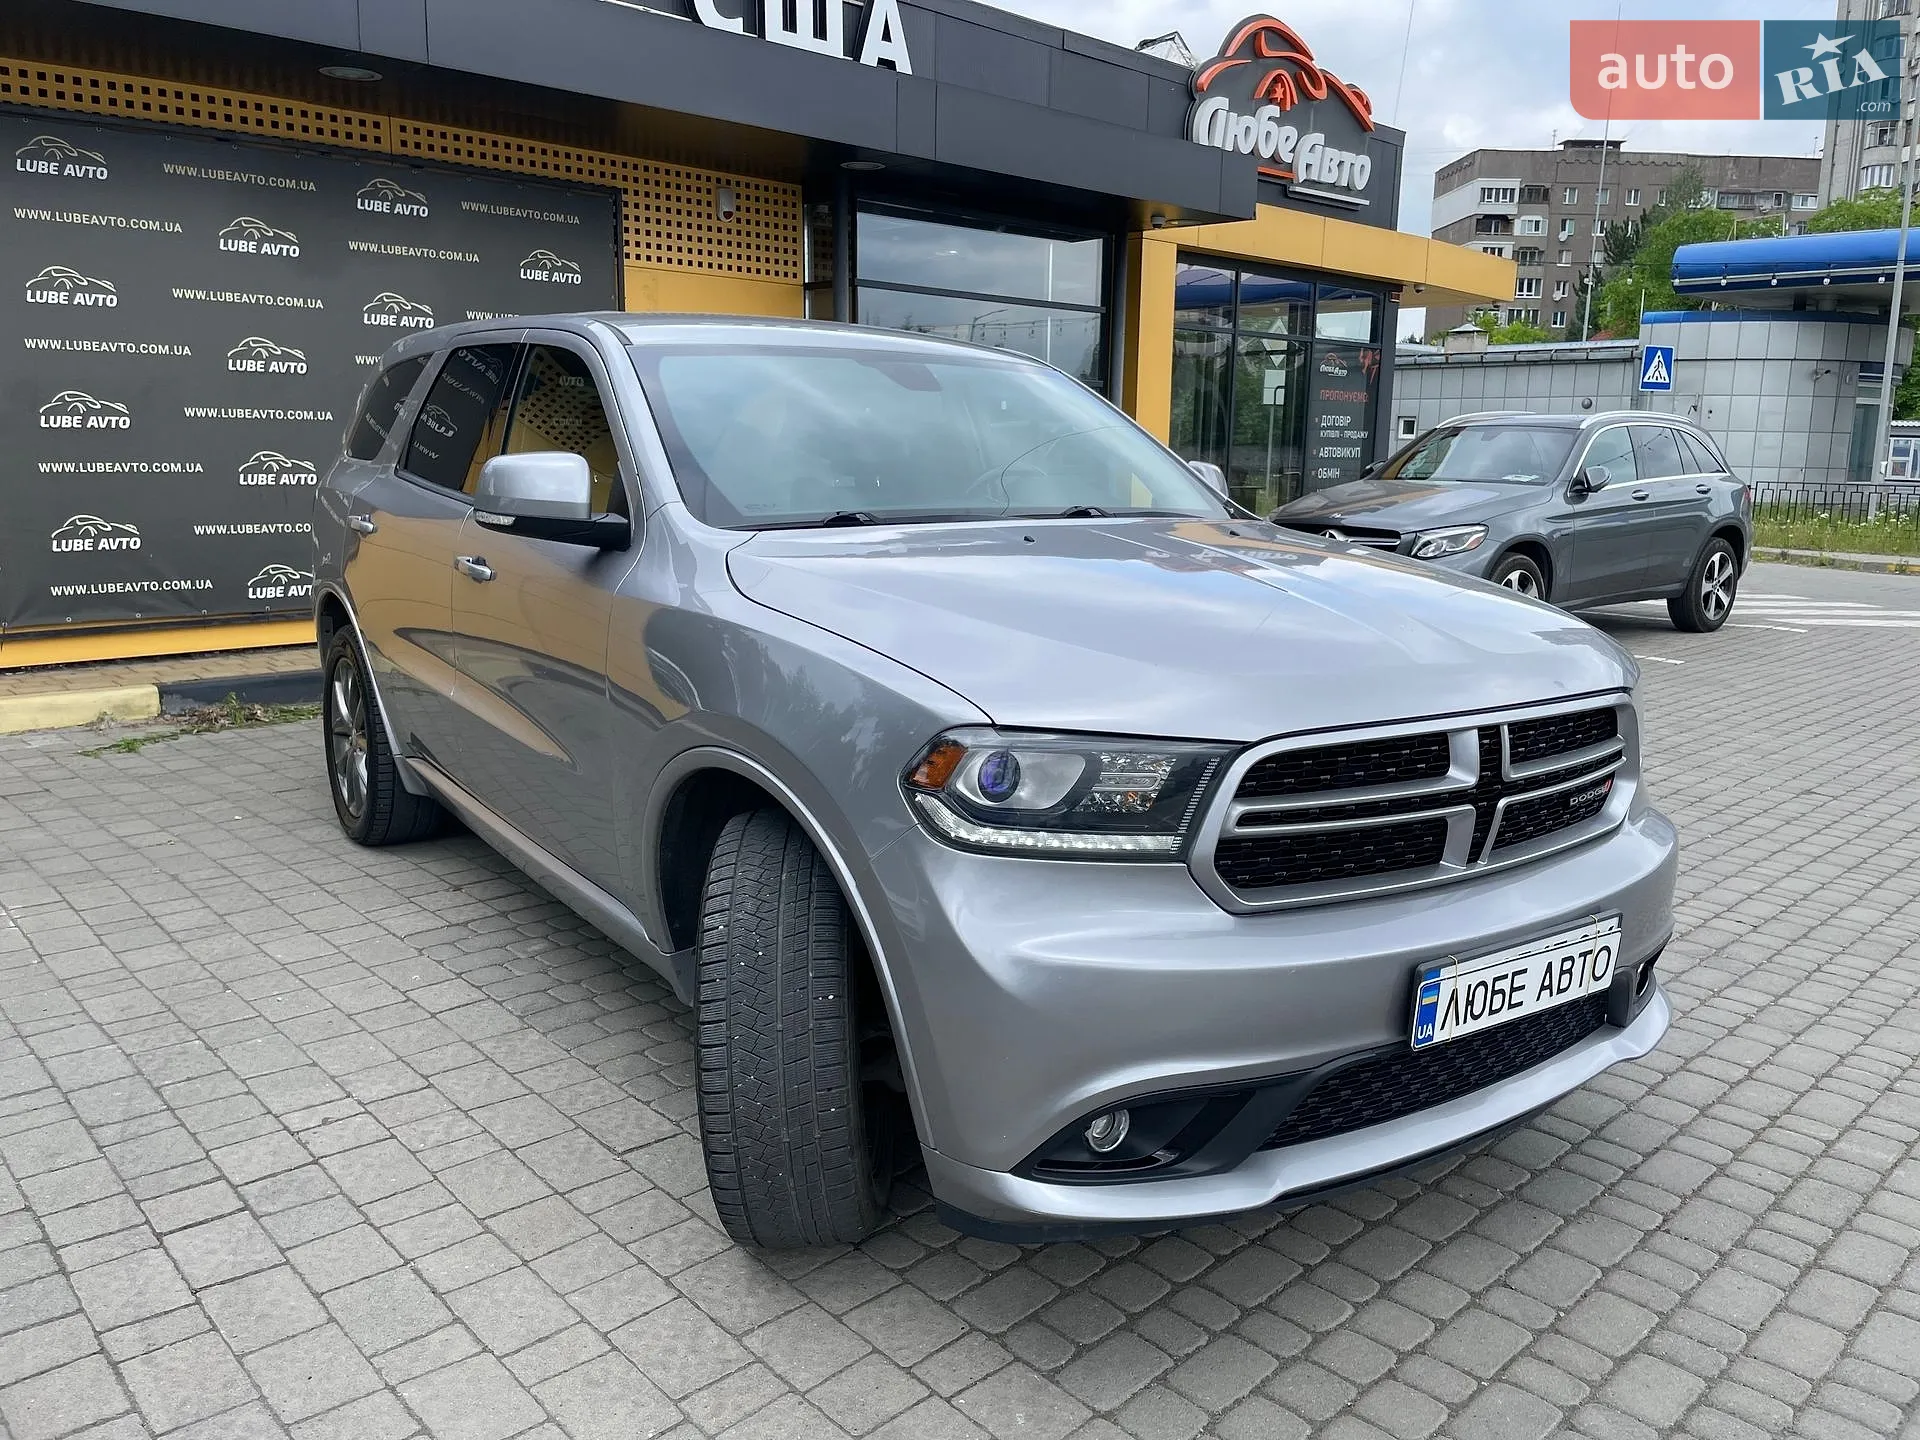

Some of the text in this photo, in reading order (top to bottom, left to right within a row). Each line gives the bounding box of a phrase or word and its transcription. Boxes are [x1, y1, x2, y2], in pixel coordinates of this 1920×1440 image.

[1192, 97, 1371, 191] Любе Авто
[16, 158, 108, 180] LUBE AVTO
[163, 163, 316, 191] WWW.LUBEAVTO.COM.UA
[356, 198, 429, 218] LUBE AVTO
[461, 201, 579, 224] WWW.LUBEAVTO.COM.UA
[14, 208, 182, 232] WWW.LUBEAVTO.COM.UA
[219, 239, 300, 258] LUBE AVTO
[349, 241, 479, 262] WWW.LUBEAVTO.COM.UA
[520, 268, 582, 284] LUBE AVTO
[26, 289, 118, 308] LUBE AVTO
[172, 288, 323, 309] WWW.LUBEAVTO.COM.UA
[363, 314, 434, 329] LUBE AVTO
[24, 339, 191, 355] WWW.LUBEAVTO.COM.UA
[228, 359, 308, 375] LUBE AVTO
[40, 415, 131, 429] LUBE AVTO
[184, 408, 333, 420] WWW.LUBEAVTO.COM.UA
[1321, 416, 1351, 427] ДОГОВІР
[1344, 431, 1368, 439] ПРОДАЖУ
[1319, 447, 1360, 458] АВТОВИКУП
[38, 463, 203, 472] WWW.LUBEAVTO.COM.UA
[1318, 468, 1340, 478] ОБМІН
[239, 473, 317, 485] LUBE AVTO
[52, 537, 141, 552] LUBE AVTO
[51, 580, 213, 596] WWW.LUBEAVTO.COM.UA
[248, 586, 284, 599] LUBE
[1570, 786, 1608, 805] DODGE
[1440, 946, 1611, 1030] ЛЮБЕ АВТО
[1418, 1024, 1433, 1039] UA
